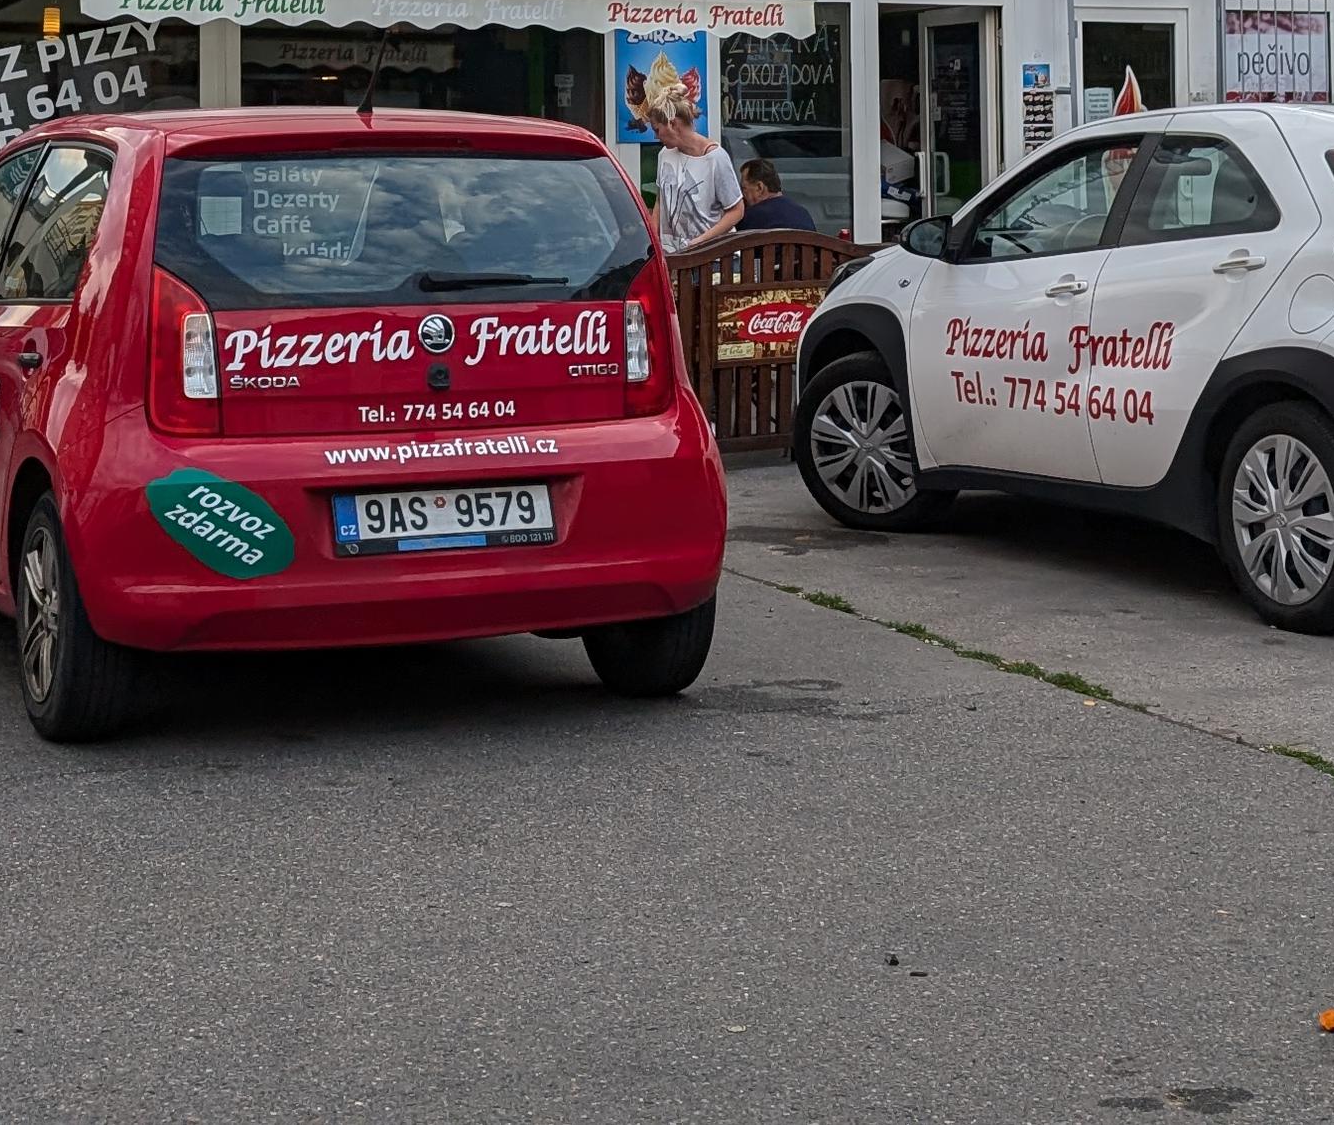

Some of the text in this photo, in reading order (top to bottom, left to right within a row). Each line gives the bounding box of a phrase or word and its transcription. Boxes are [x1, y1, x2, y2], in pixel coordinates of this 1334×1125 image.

[607, 1, 785, 29] Pizzeria Fratelli
[37, 22, 161, 73] PIZZY
[1237, 43, 1310, 82] pečivo
[26, 79, 83, 120] 64
[93, 65, 148, 105] 04
[253, 165, 323, 187] Saláty
[253, 189, 340, 212] Dezerty
[253, 215, 312, 234] Caffé
[747, 311, 804, 335] Coca-Cola
[224, 310, 611, 371] Pizzeria Fratelli
[945, 316, 1175, 374] Pizzeria Fratelli
[230, 375, 301, 389] ŠKODA
[568, 363, 619, 377] CITIGO
[359, 400, 516, 423] Tel.: 774 54 64 04
[951, 370, 1155, 425] Tel.: 774 54 64 04
[325, 435, 559, 465] www.pizzafratelli.cz
[188, 485, 276, 540] rozvoz
[364, 490, 535, 534] 9AS 9579
[164, 504, 264, 565] zdarma
[340, 524, 357, 536] CZ
